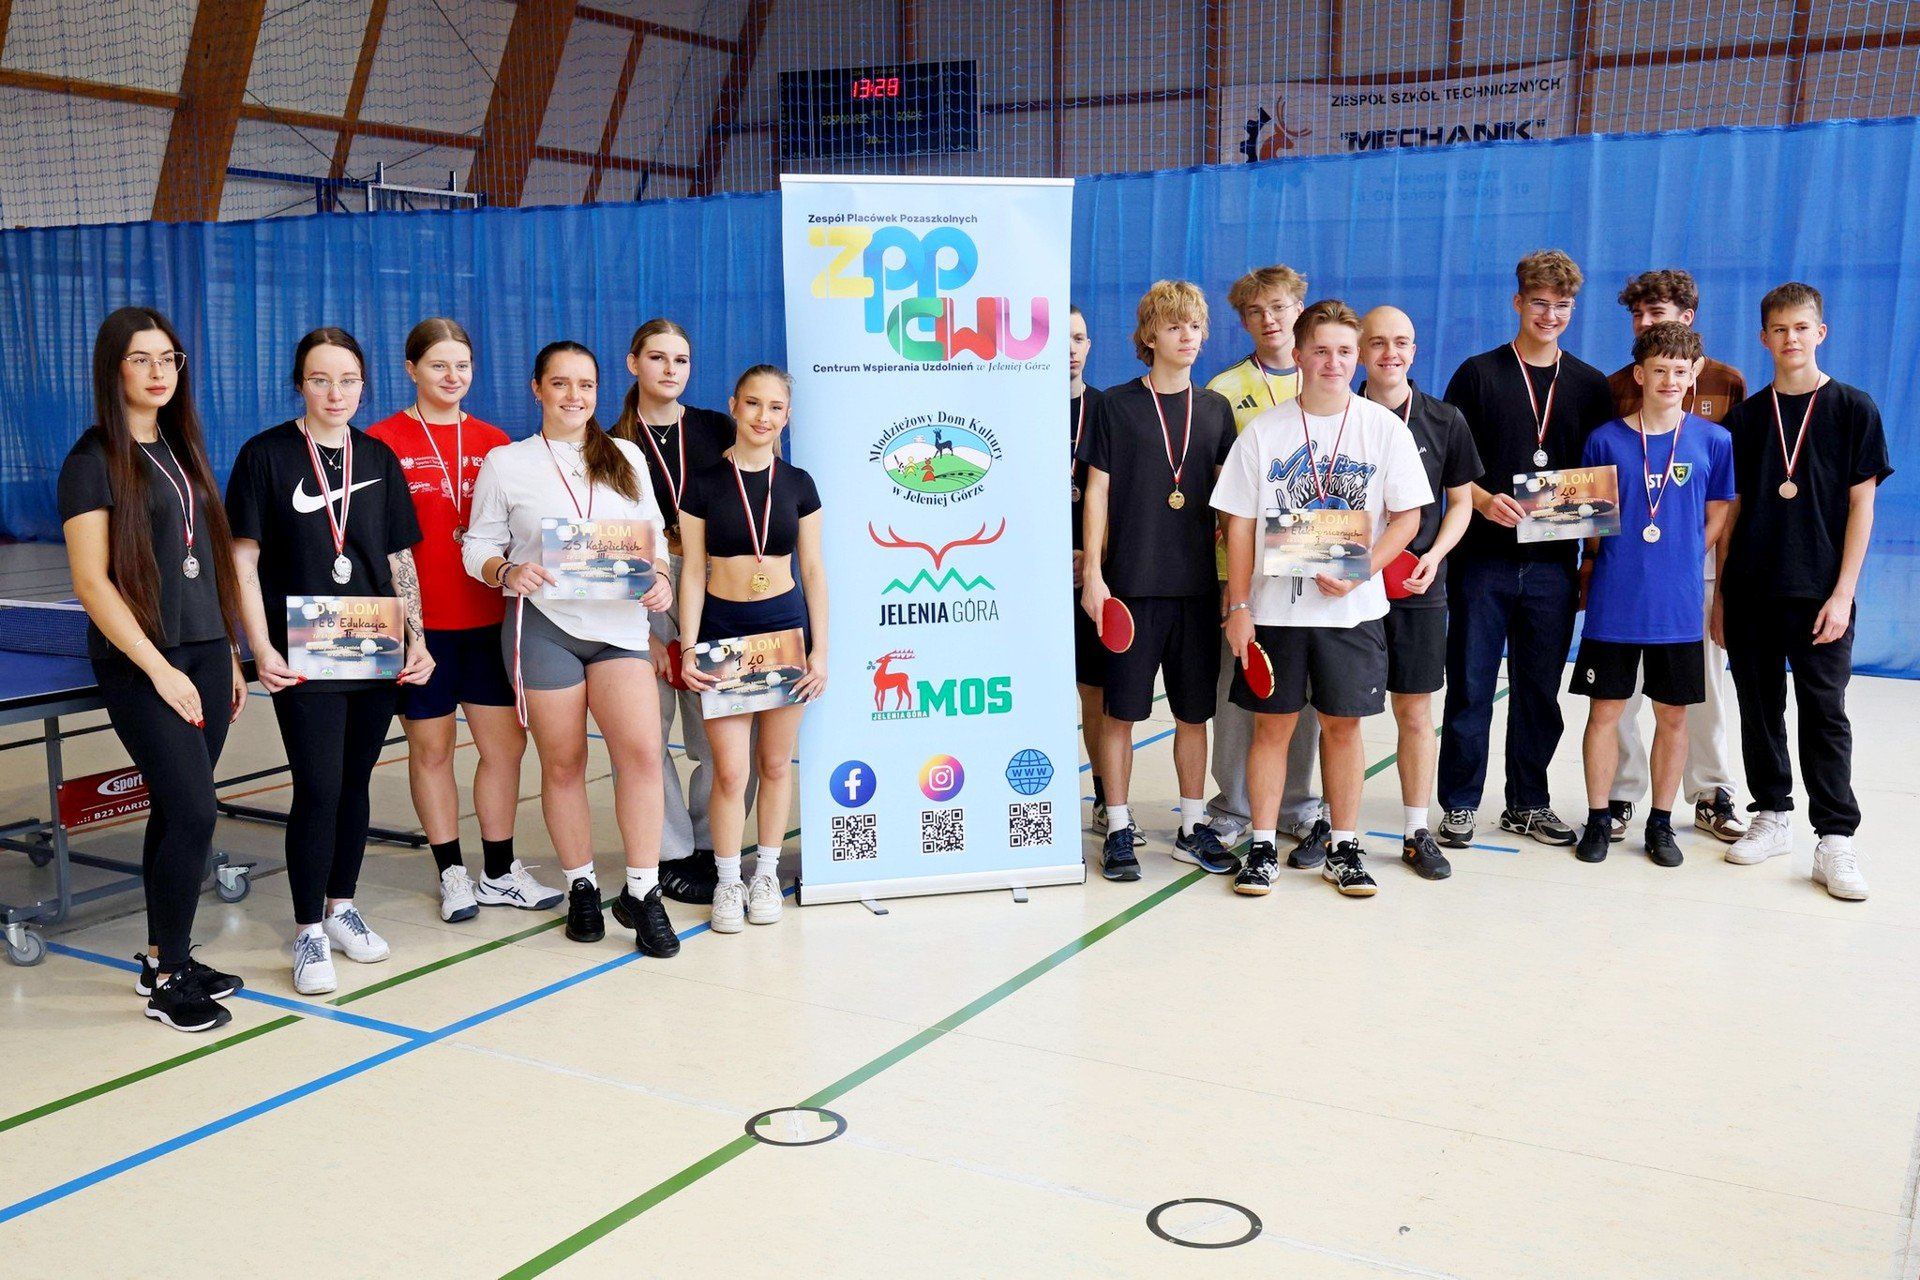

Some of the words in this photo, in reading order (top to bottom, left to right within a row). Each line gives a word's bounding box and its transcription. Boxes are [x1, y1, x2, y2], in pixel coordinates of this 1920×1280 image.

[1391, 88, 1440, 104] SZKÓŁ
[1443, 78, 1561, 100] TECHNICZNYCH
[808, 213, 845, 225] Zespół
[847, 213, 898, 223] Placówek
[900, 214, 978, 225] Pozaszkolnych
[813, 363, 861, 373] Centrum
[862, 363, 920, 374] Wspierania
[922, 361, 973, 372] Uzdolnień
[987, 361, 1022, 374] Jeleniej
[1024, 361, 1051, 371] Górze
[869, 413, 934, 463] Młodzieżowy
[938, 410, 966, 427] Dom
[969, 418, 1003, 461] Kultury
[892, 486, 901, 496] w
[903, 490, 948, 507] Jeleniej
[950, 484, 985, 503] Górze
[879, 602, 949, 626] JELENIA
[952, 597, 1000, 622] GÓRA
[916, 676, 1013, 717] MOS
[872, 711, 904, 721] JELENIA
[906, 710, 928, 719] GÓRA
[113, 774, 144, 792] sport
[94, 809, 114, 820] B22
[117, 800, 151, 813] VARIO
